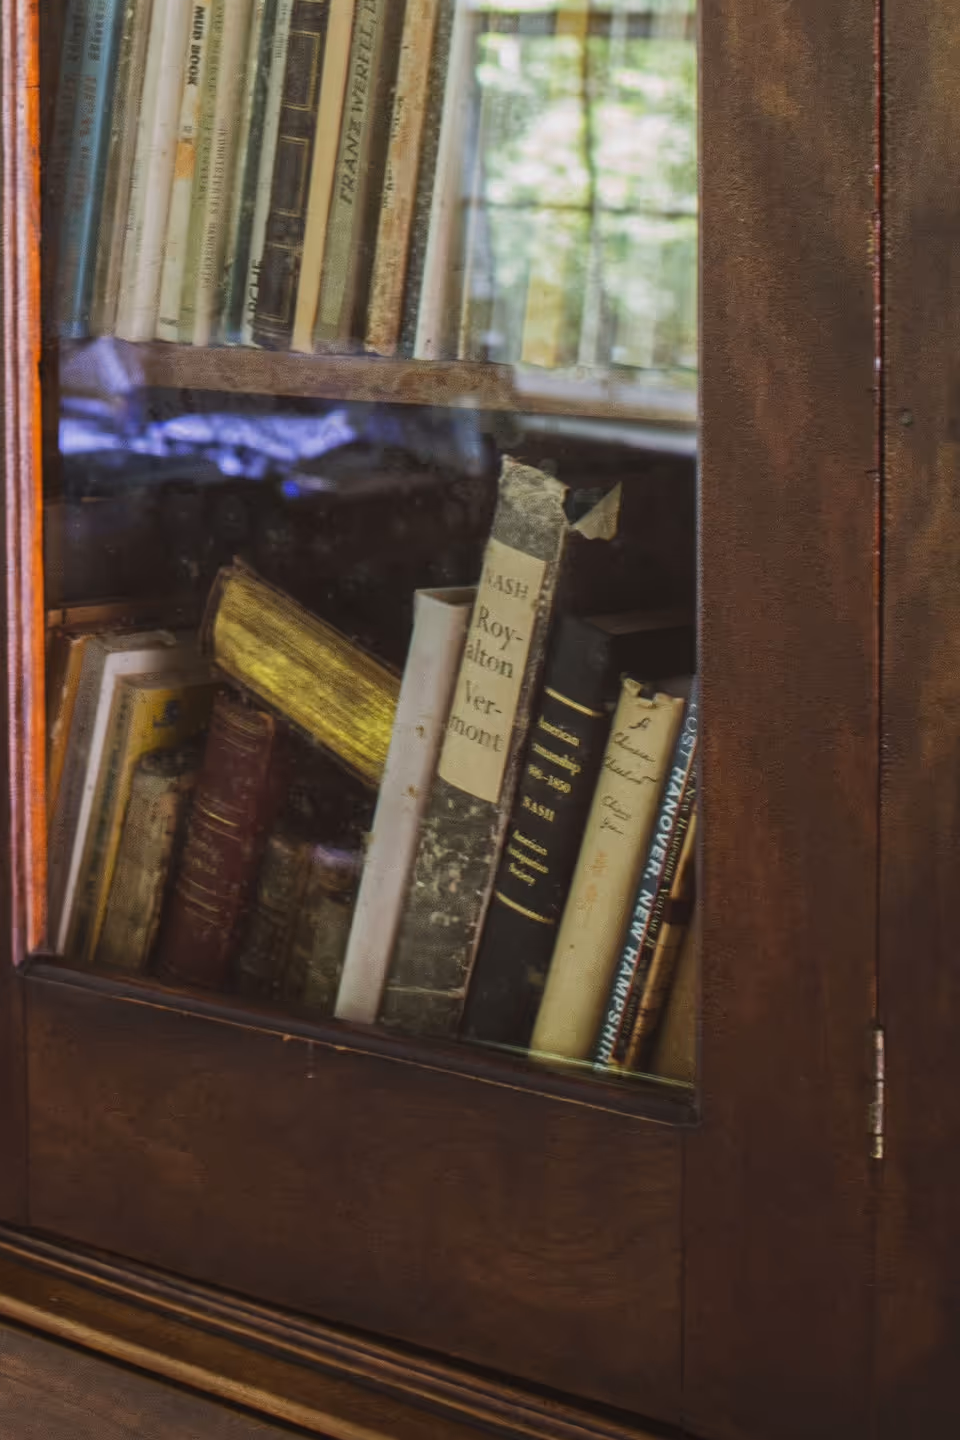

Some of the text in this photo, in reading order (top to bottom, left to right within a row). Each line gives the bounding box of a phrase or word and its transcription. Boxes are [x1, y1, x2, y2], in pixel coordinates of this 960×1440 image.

[187, 5, 206, 87] MUD BOOK
[340, 118, 363, 206] FRANZ
[476, 605, 524, 651] Roy-
[465, 638, 514, 679] alton
[466, 679, 503, 715] Ver-
[449, 715, 504, 753] mont
[643, 766, 687, 880] HANOVER,
[630, 888, 656, 942] NEW
